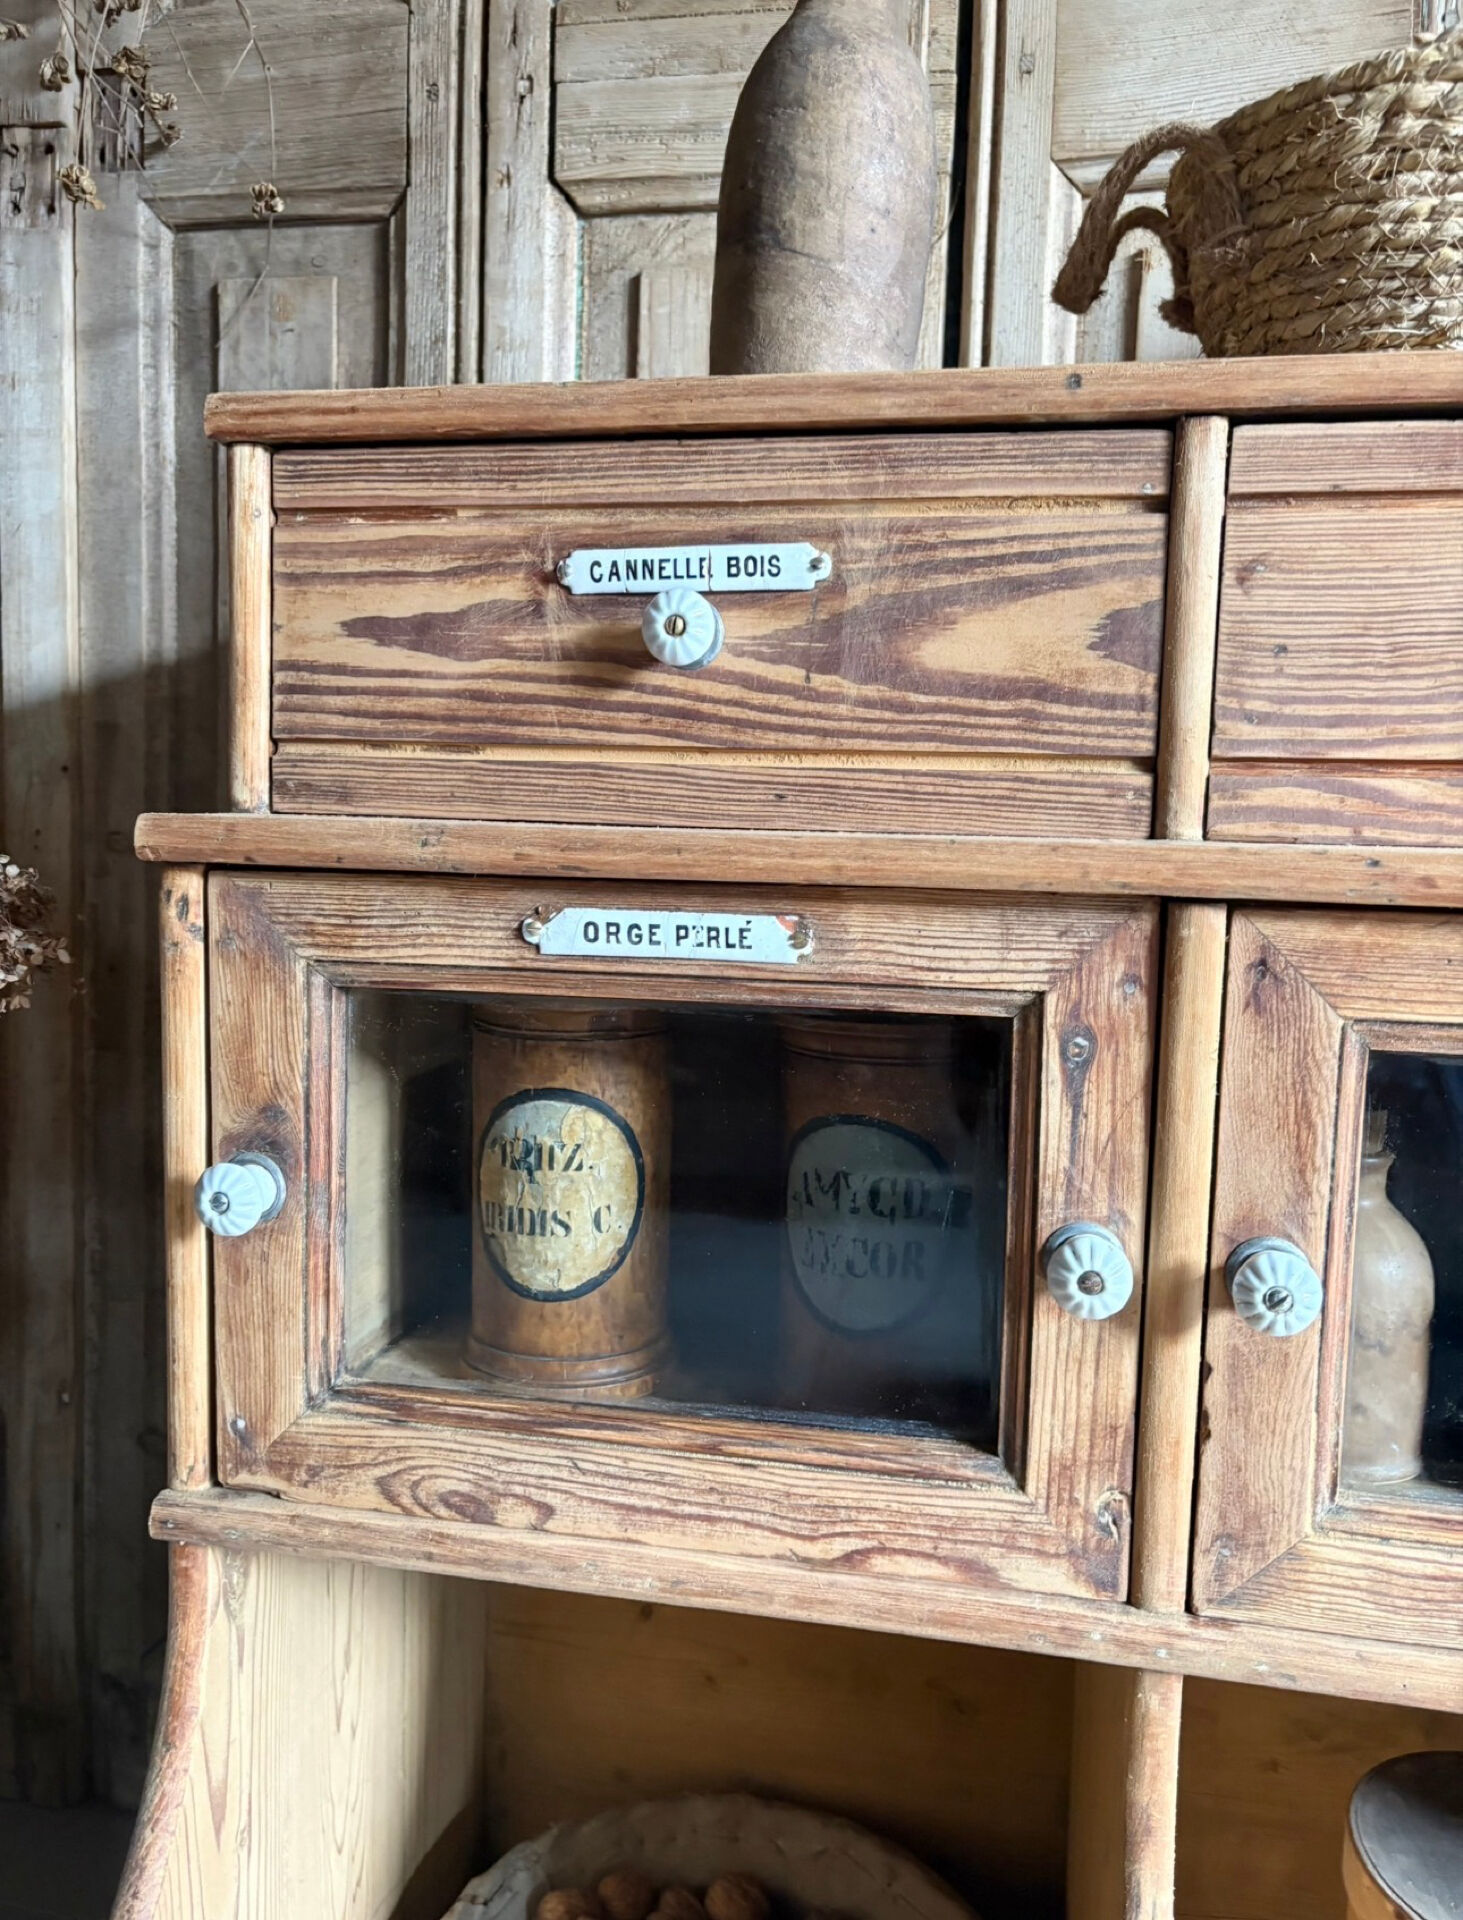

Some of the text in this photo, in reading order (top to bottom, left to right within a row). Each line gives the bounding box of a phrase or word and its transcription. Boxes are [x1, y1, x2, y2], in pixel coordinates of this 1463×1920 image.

[590, 555, 781, 583] CANNELLE BOIS
[583, 921, 662, 946] ORGE
